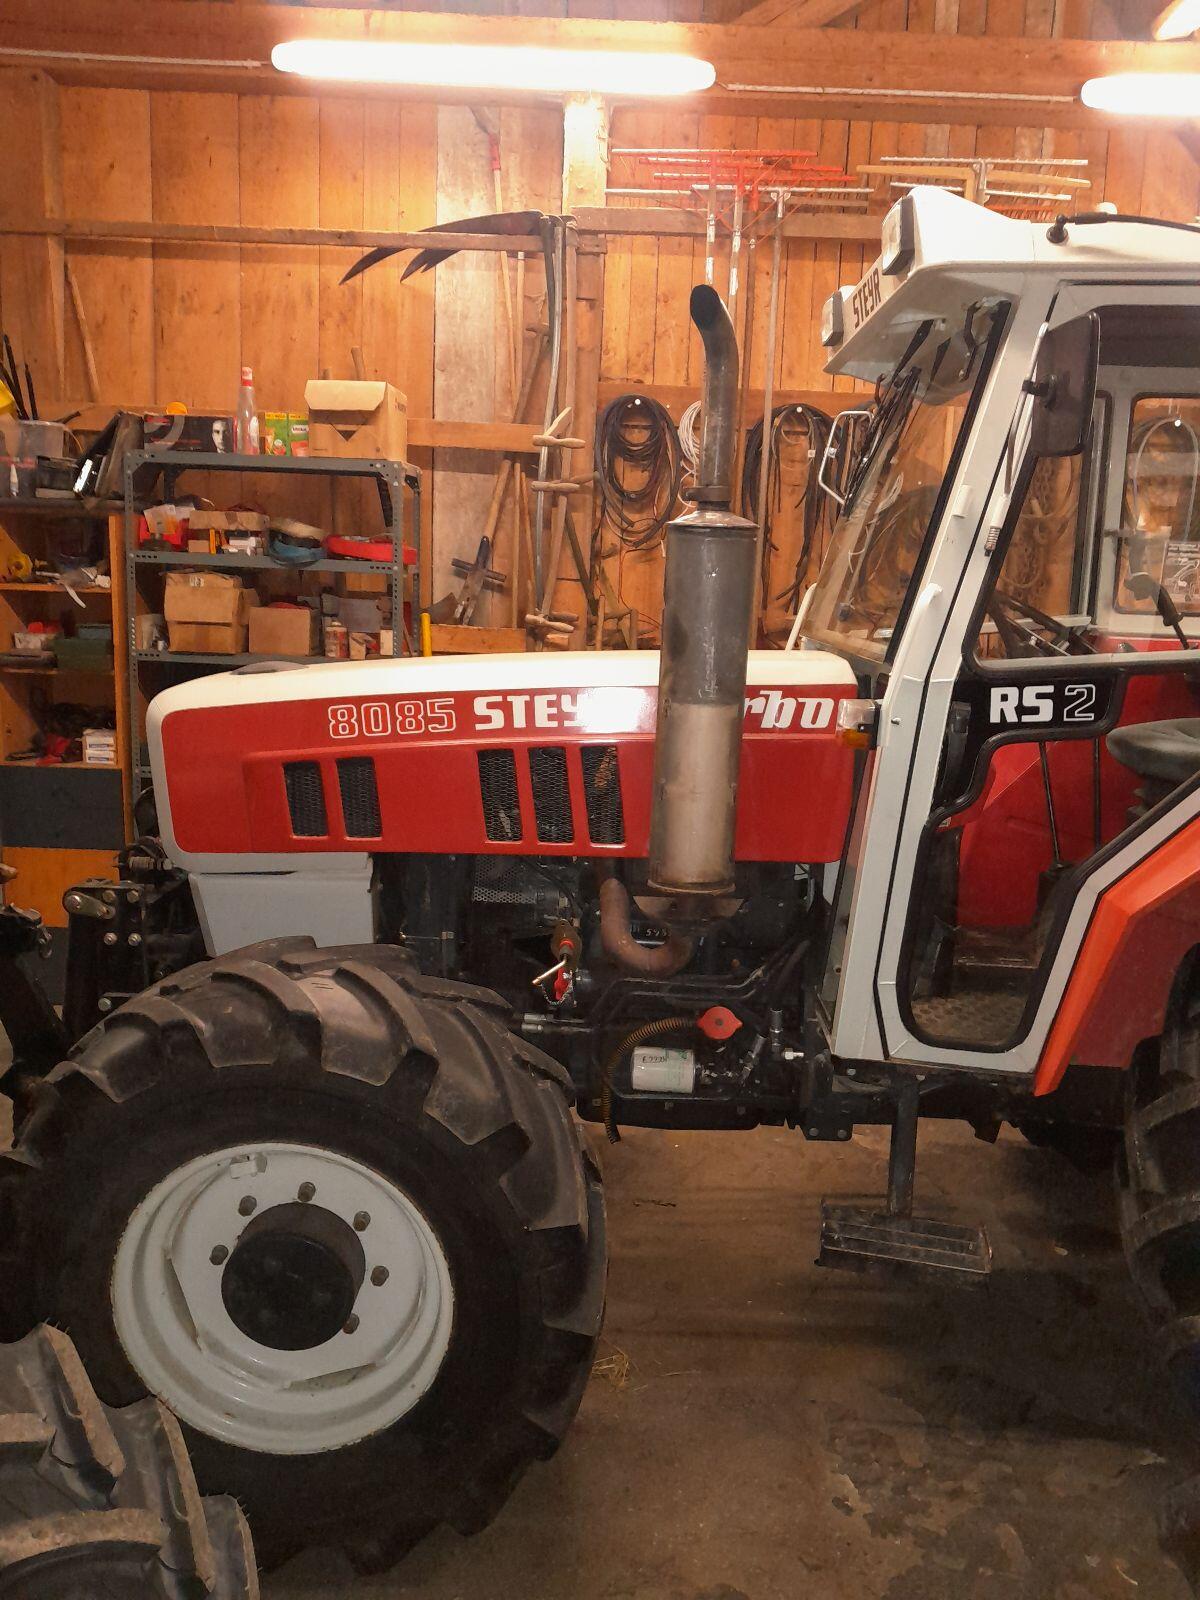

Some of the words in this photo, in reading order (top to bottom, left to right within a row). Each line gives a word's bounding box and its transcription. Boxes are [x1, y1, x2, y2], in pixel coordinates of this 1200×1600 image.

[852, 267, 882, 330] STEYR
[327, 697, 457, 739] 8085
[473, 693, 590, 731] STEY
[744, 689, 835, 729] rbo
[989, 684, 1055, 724] RS
[1063, 683, 1096, 722] 2
